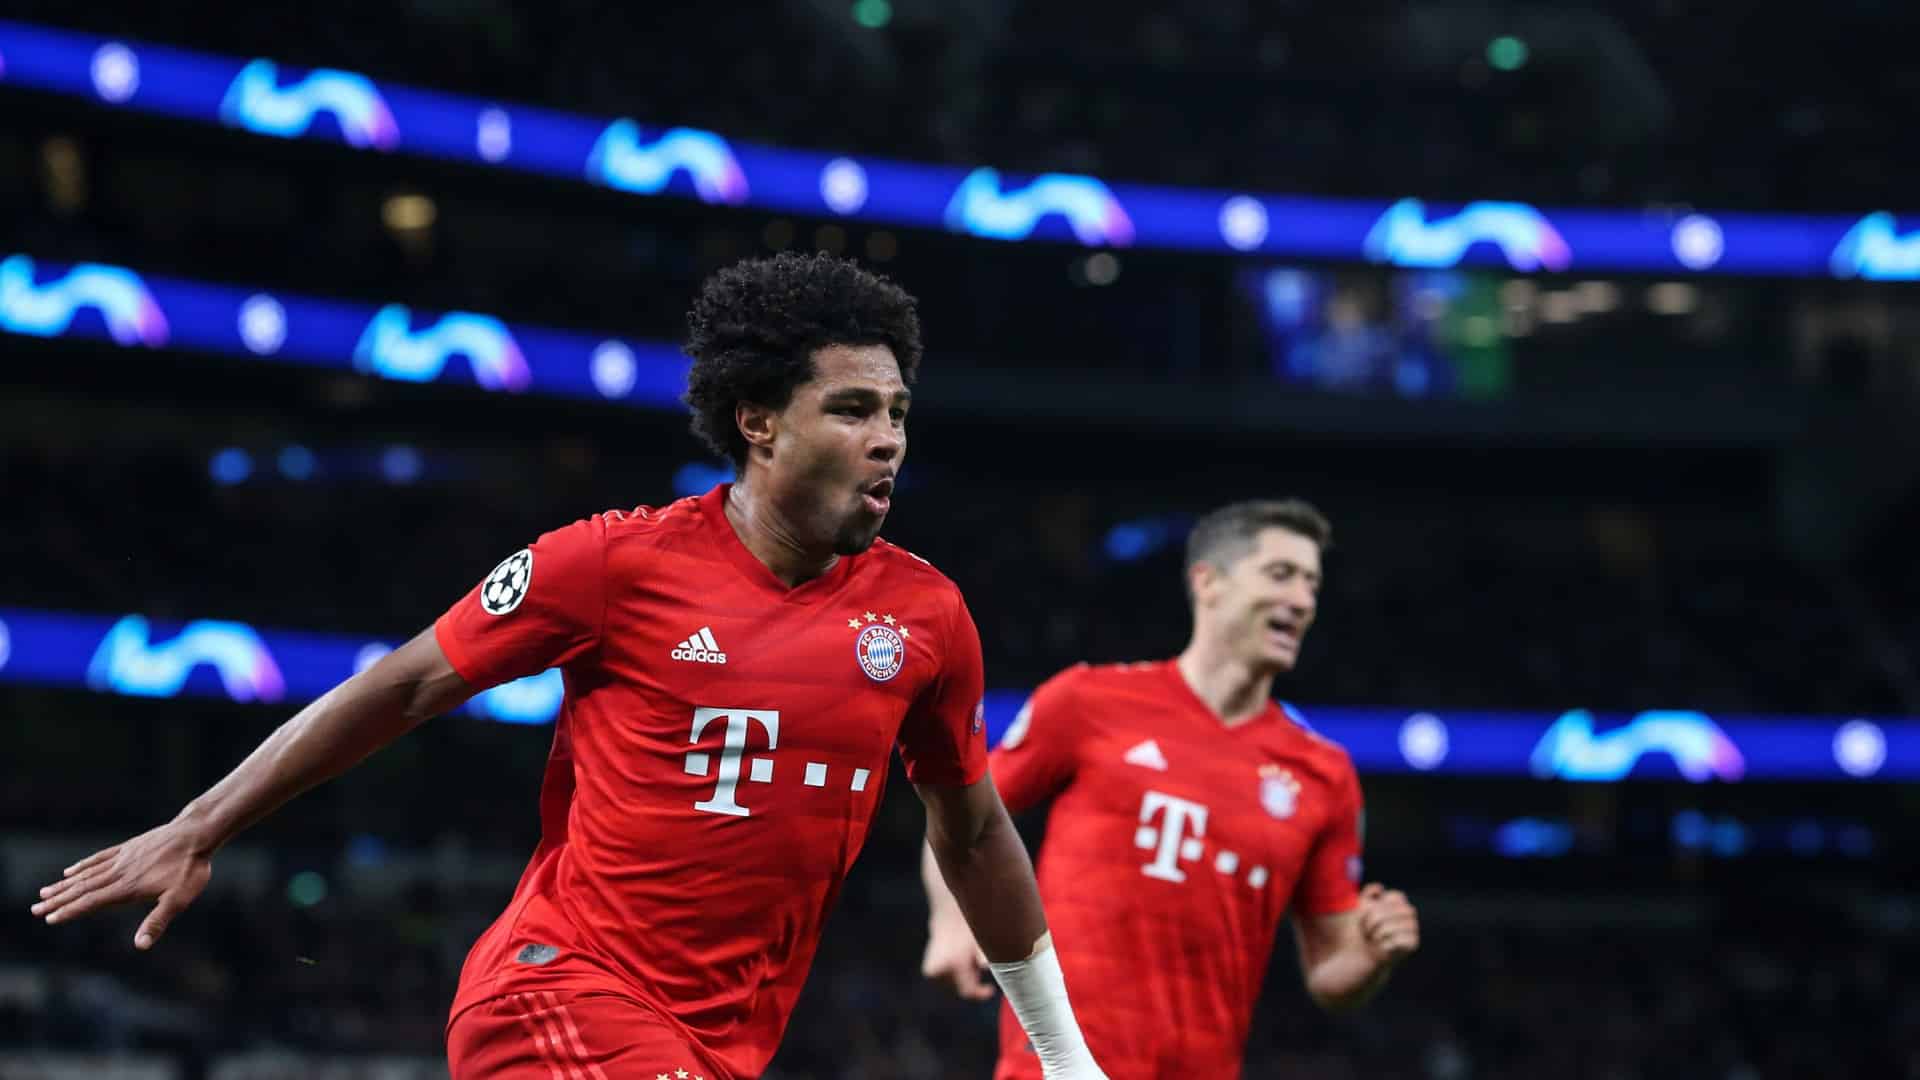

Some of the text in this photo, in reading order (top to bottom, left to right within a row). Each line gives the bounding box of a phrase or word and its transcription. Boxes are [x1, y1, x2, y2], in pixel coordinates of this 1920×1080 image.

[862, 629, 901, 653] FC BAYERN
[671, 648, 727, 664] adidas
